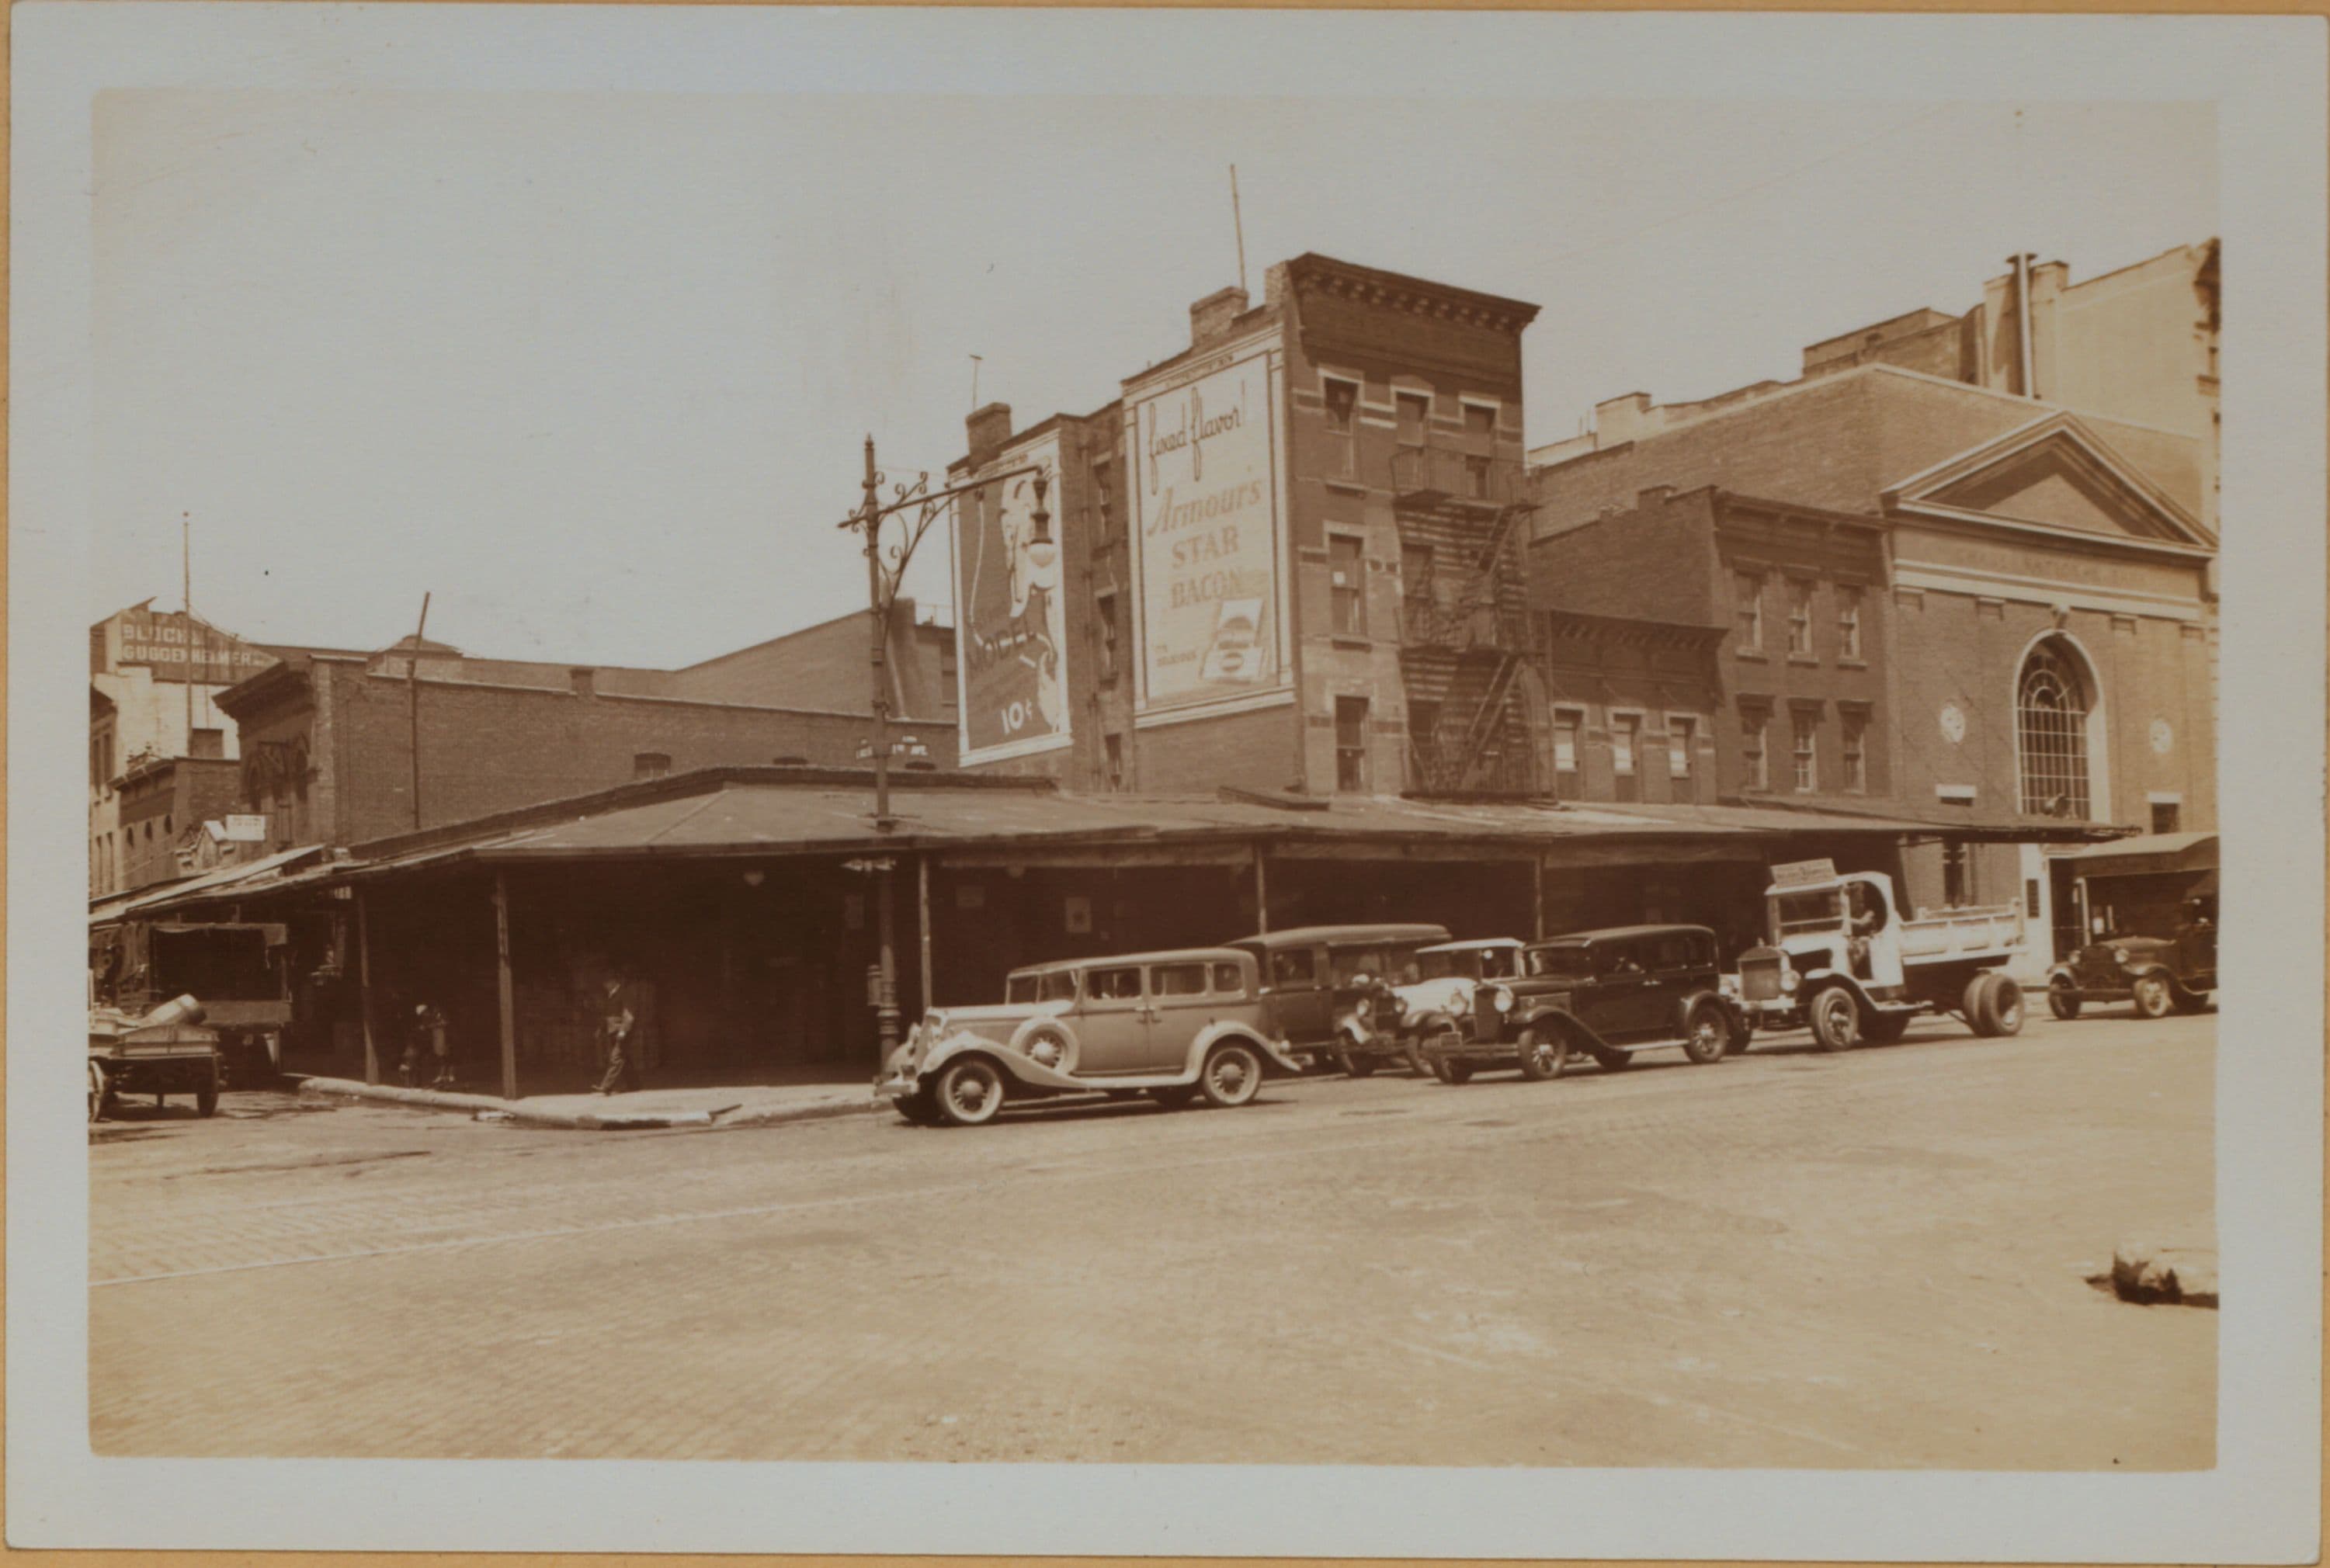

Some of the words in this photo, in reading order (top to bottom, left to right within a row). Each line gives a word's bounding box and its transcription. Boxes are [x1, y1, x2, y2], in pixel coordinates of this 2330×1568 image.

[1171, 526, 1239, 568] STAR
[1170, 571, 1245, 609] BACON
[966, 619, 1036, 674] MODEL
